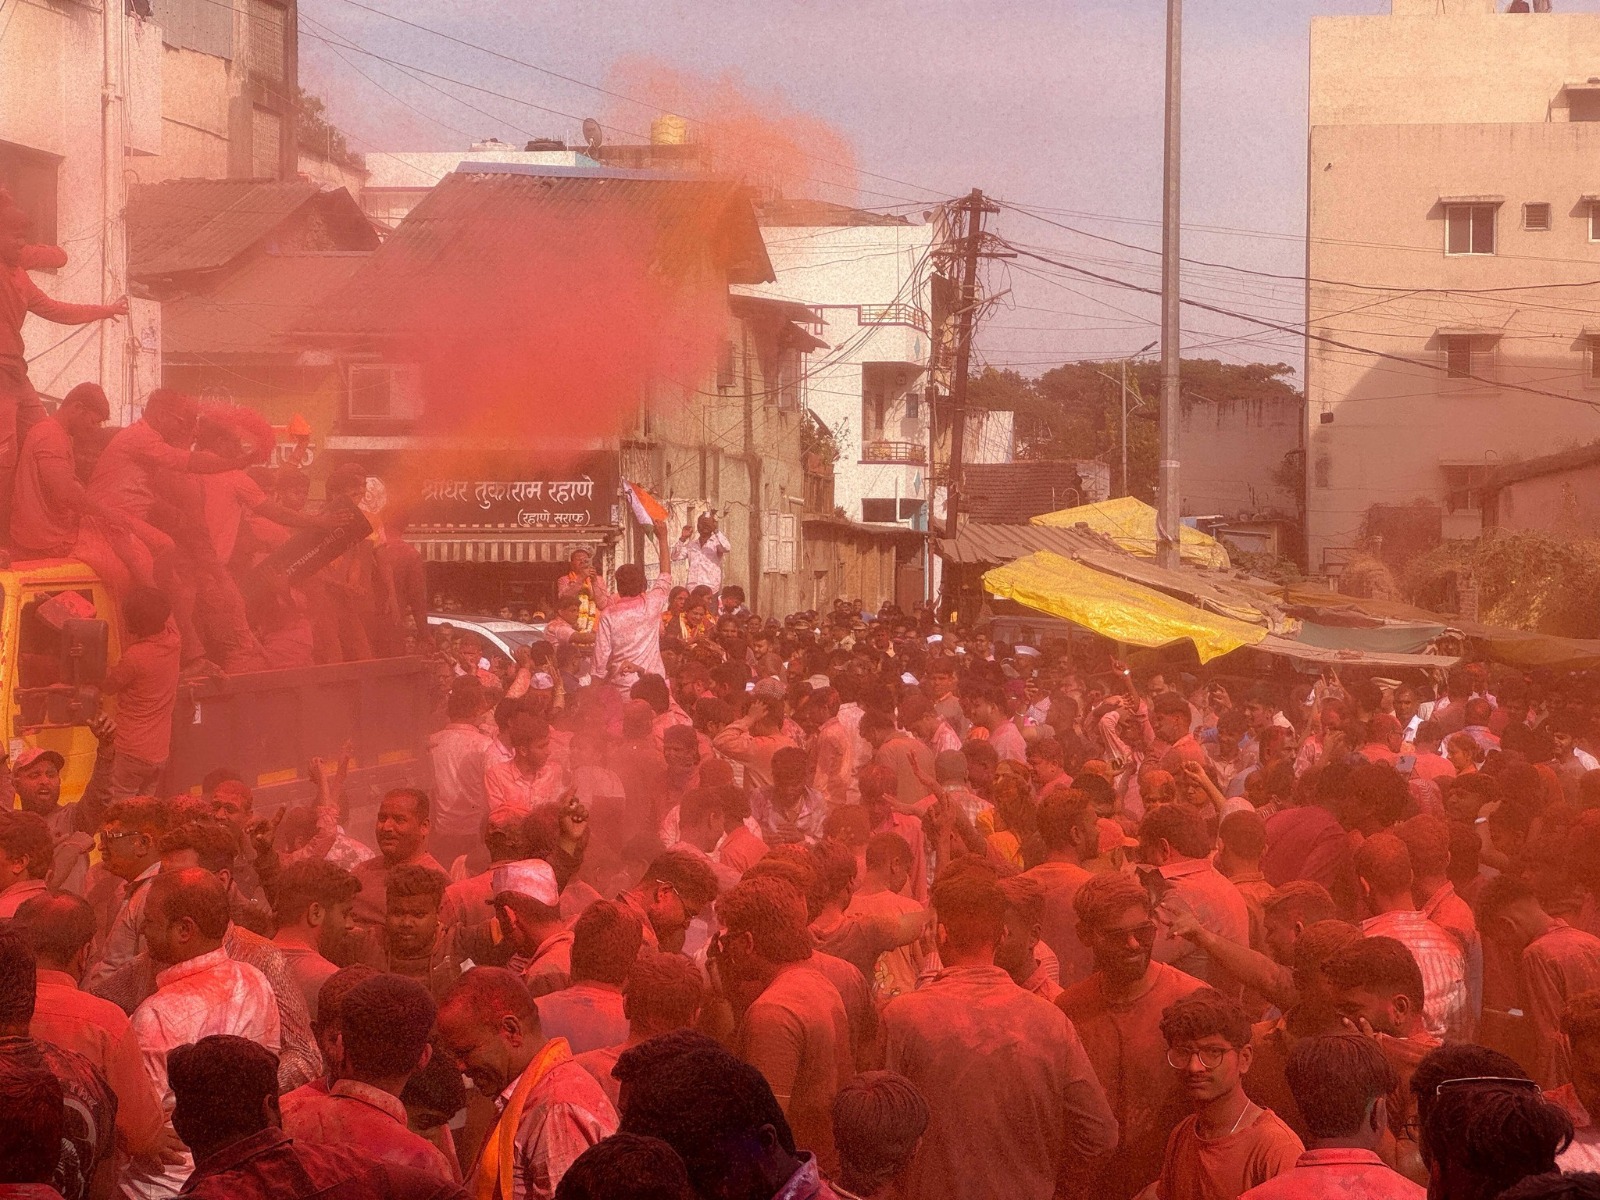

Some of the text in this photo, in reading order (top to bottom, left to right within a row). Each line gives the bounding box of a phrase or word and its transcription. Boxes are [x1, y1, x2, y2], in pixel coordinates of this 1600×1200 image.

[475, 481, 543, 510] तुकाराम
[549, 474, 595, 505] रहाणे
[517, 509, 591, 527] (रहाणे सराफ)
